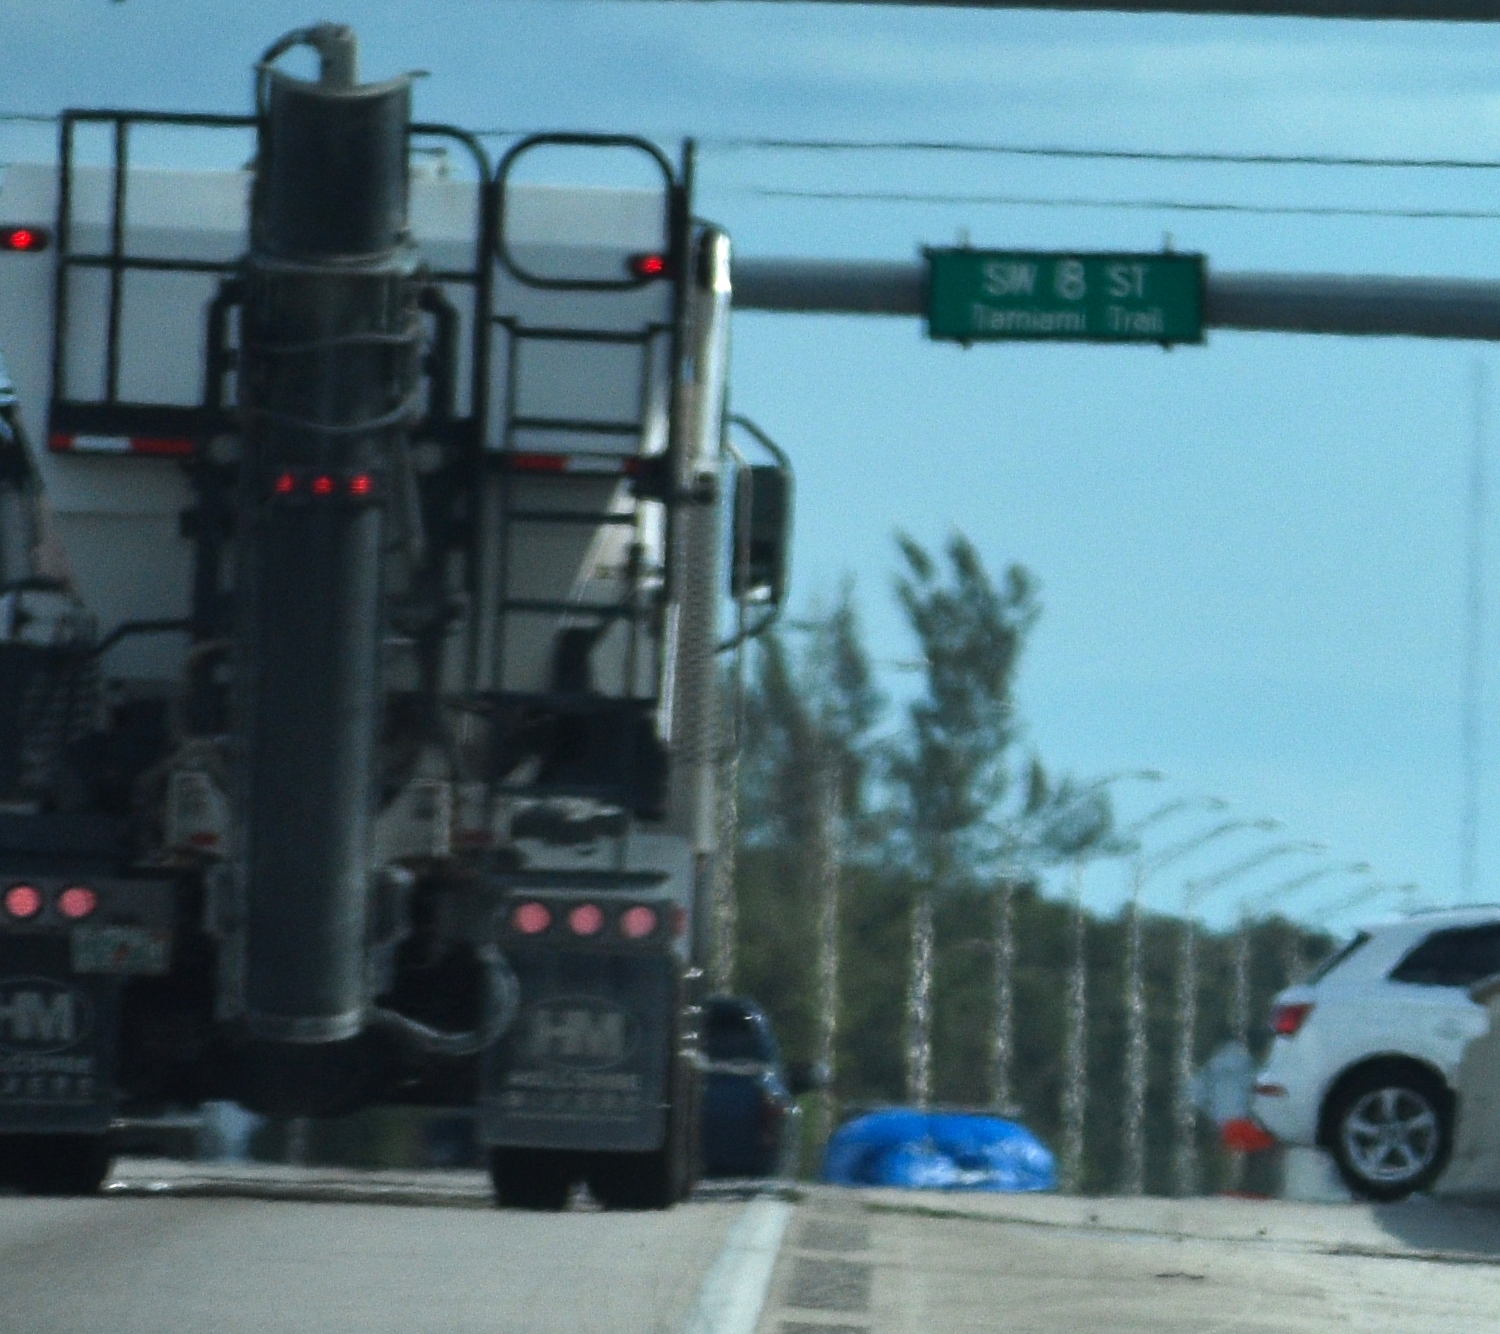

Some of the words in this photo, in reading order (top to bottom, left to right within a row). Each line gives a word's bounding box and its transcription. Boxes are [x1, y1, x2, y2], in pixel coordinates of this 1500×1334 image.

[981, 263, 1038, 297] SW
[1054, 259, 1087, 301] 8
[1108, 263, 1149, 298] ST
[973, 303, 1087, 332] Tamiami
[1108, 305, 1165, 334] Trail
